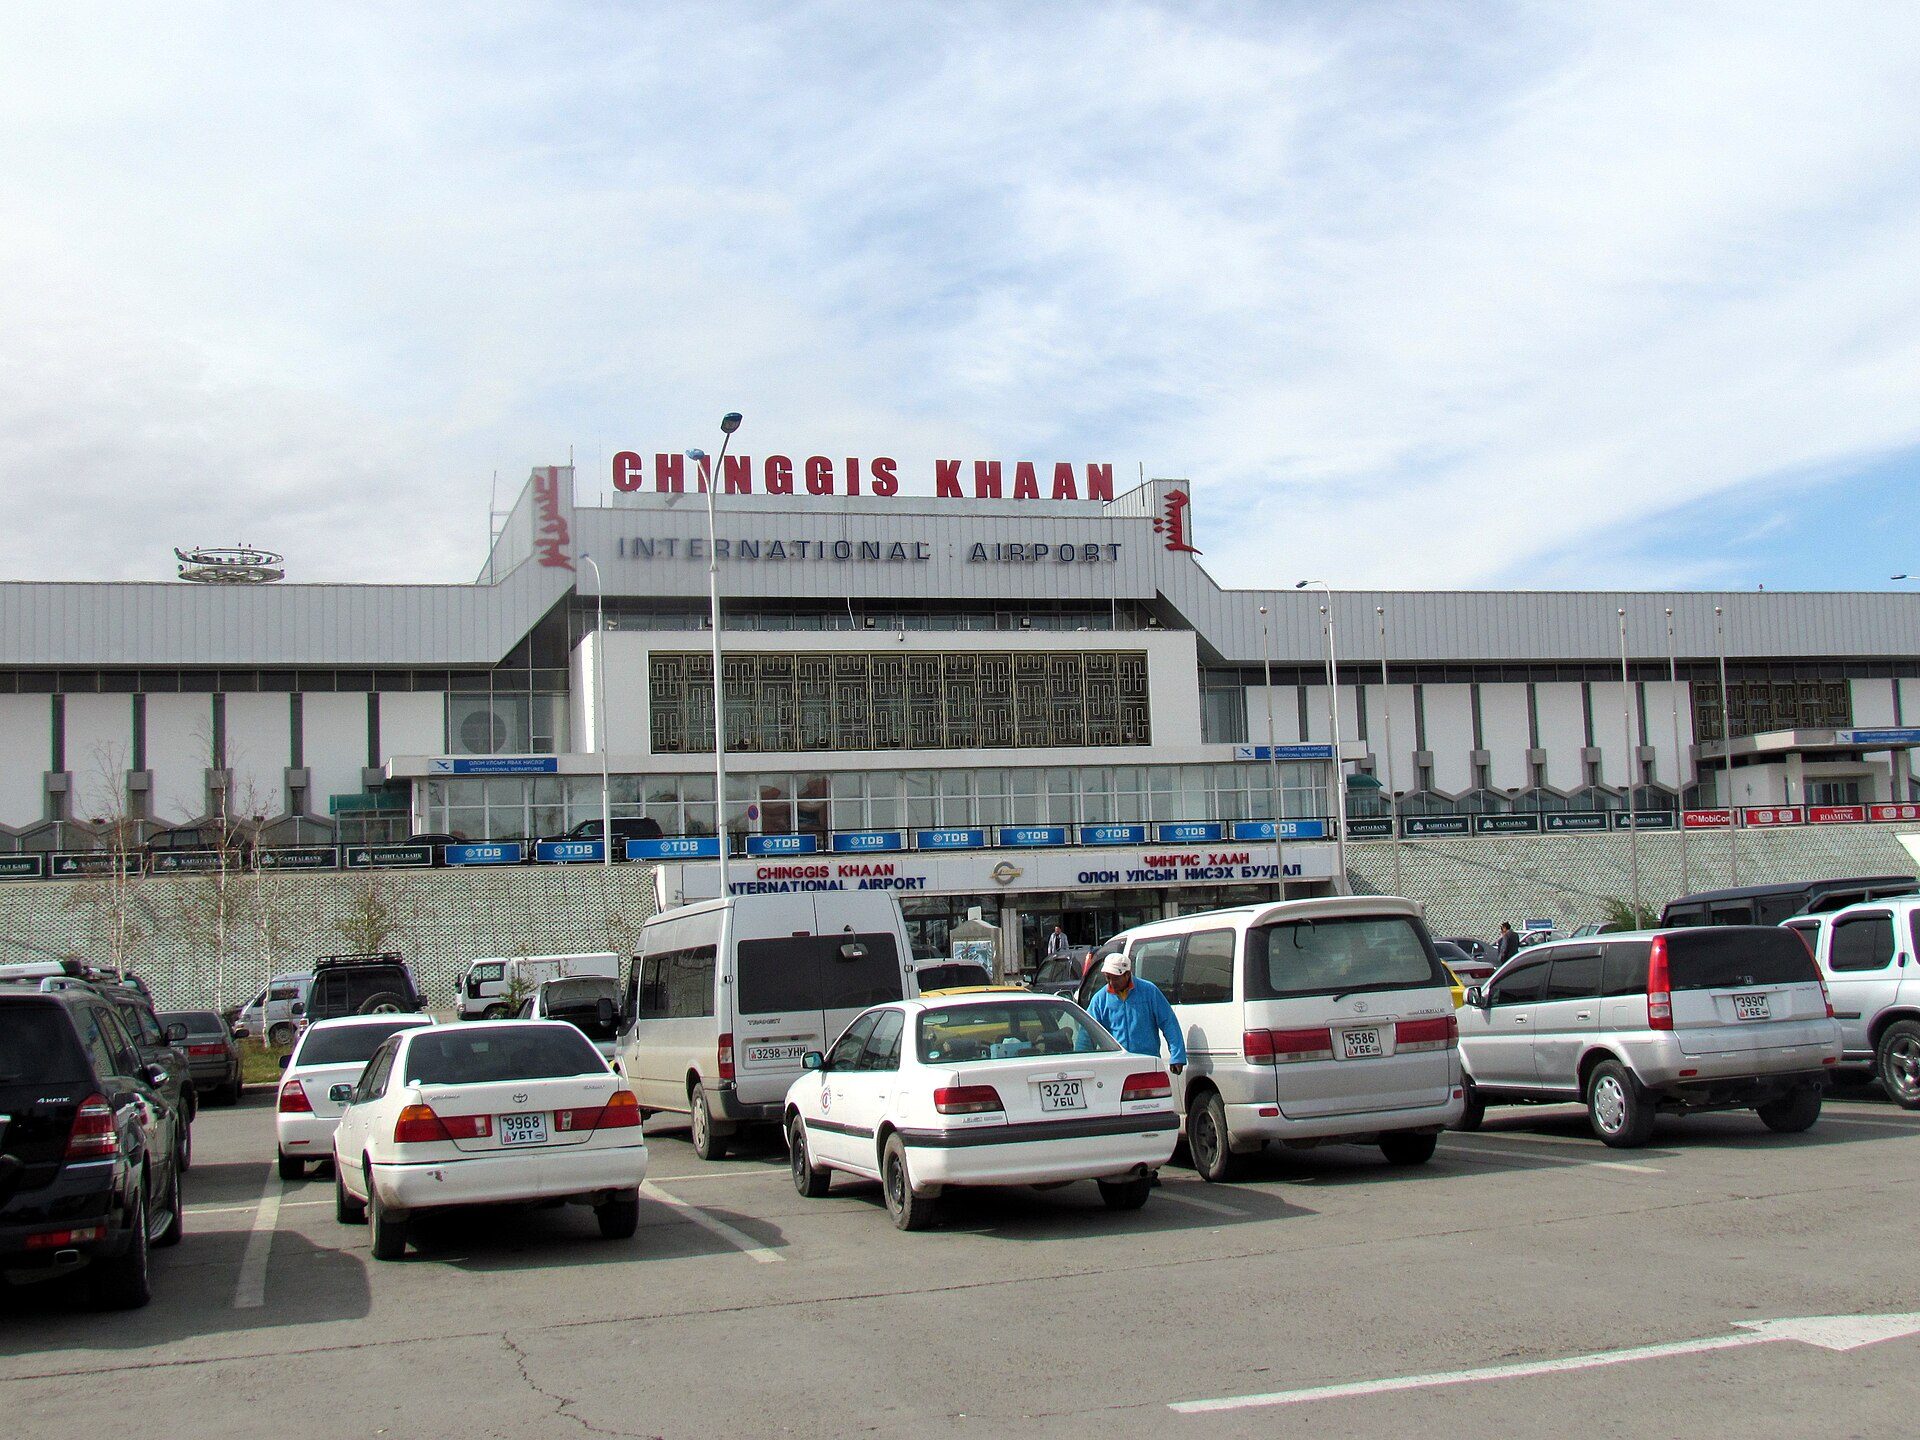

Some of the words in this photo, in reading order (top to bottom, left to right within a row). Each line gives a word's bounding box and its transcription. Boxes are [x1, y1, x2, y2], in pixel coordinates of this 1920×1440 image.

[612, 451, 898, 496] CHINGGIS
[936, 460, 1114, 501] KHAAN
[618, 537, 930, 560] INTERNATIONAL
[970, 542, 1122, 562] AIRPORT
[1105, 829, 1130, 837] TDB
[1184, 827, 1206, 835] TDB
[774, 839, 800, 847] TDB
[860, 836, 883, 844] TDB
[943, 833, 968, 842] TDB
[566, 845, 593, 854] TDB
[671, 841, 698, 851] TDB
[476, 849, 501, 857] TDB
[1144, 854, 1200, 867] ЧИНГИС
[1208, 853, 1249, 865] ХААН
[757, 866, 830, 880] CHINGGIS
[838, 864, 894, 877] KHAAN
[1078, 870, 1119, 883] ОЛОН
[1126, 869, 1177, 882] УЛСЫН
[1184, 867, 1234, 879] НИСЭХ
[1241, 865, 1301, 878] БУУДАЛ
[728, 879, 848, 894] NTERNATIONAL
[858, 877, 926, 890] AIRPORT
[1740, 996, 1764, 1008] 3990
[1349, 1032, 1374, 1044] 5586
[1053, 1098, 1074, 1107] УБЦ
[506, 1117, 540, 1130] 9968
[512, 1130, 533, 1141] УБТ
